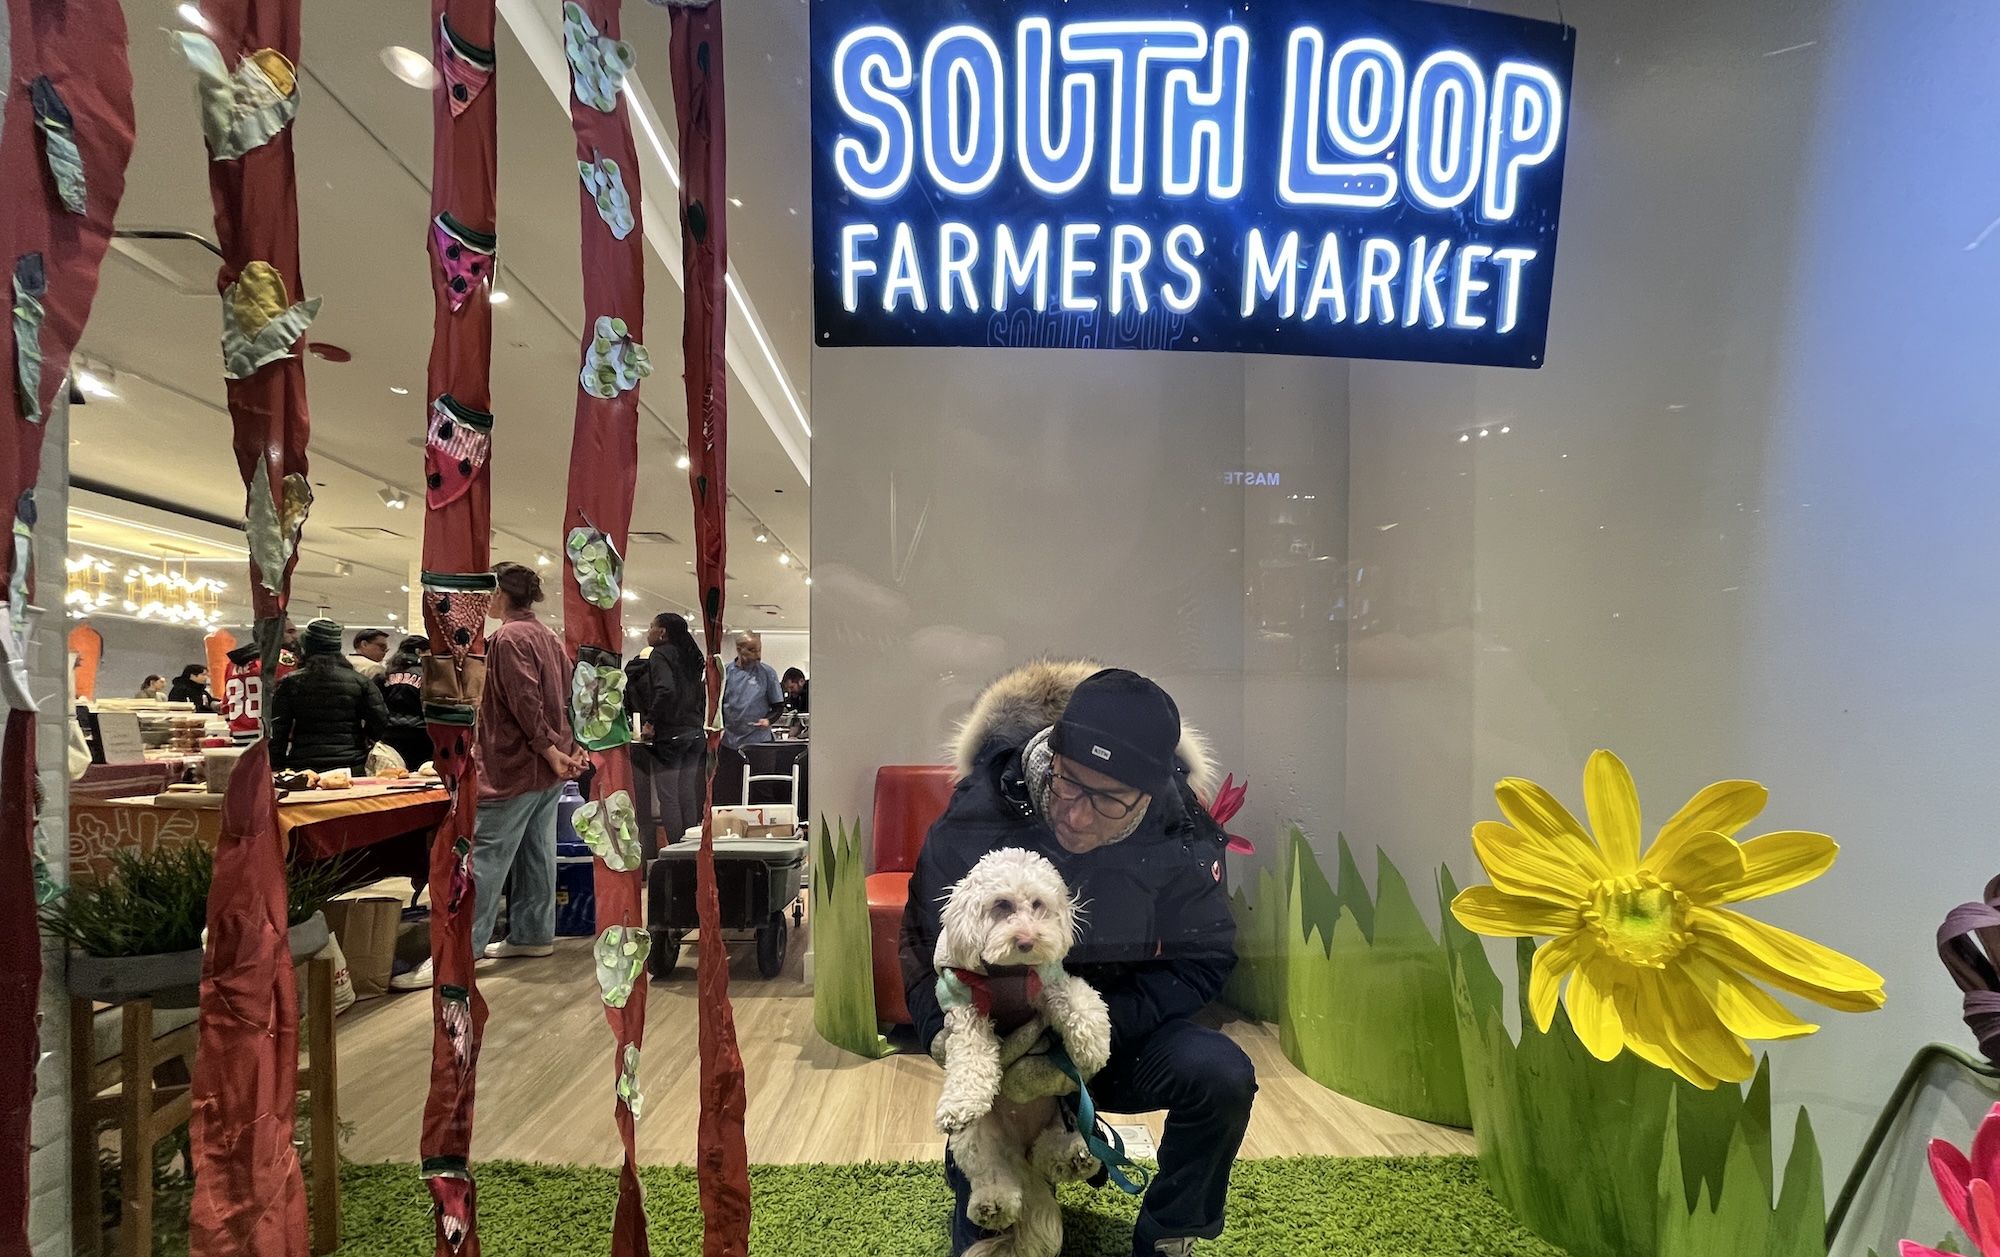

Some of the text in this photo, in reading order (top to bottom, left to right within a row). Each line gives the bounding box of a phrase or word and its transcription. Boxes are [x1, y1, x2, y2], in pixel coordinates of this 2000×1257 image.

[832, 17, 1561, 221] SOUTH LOOP
[841, 222, 1536, 334] FARMERS MARKET
[226, 676, 263, 720] 88
